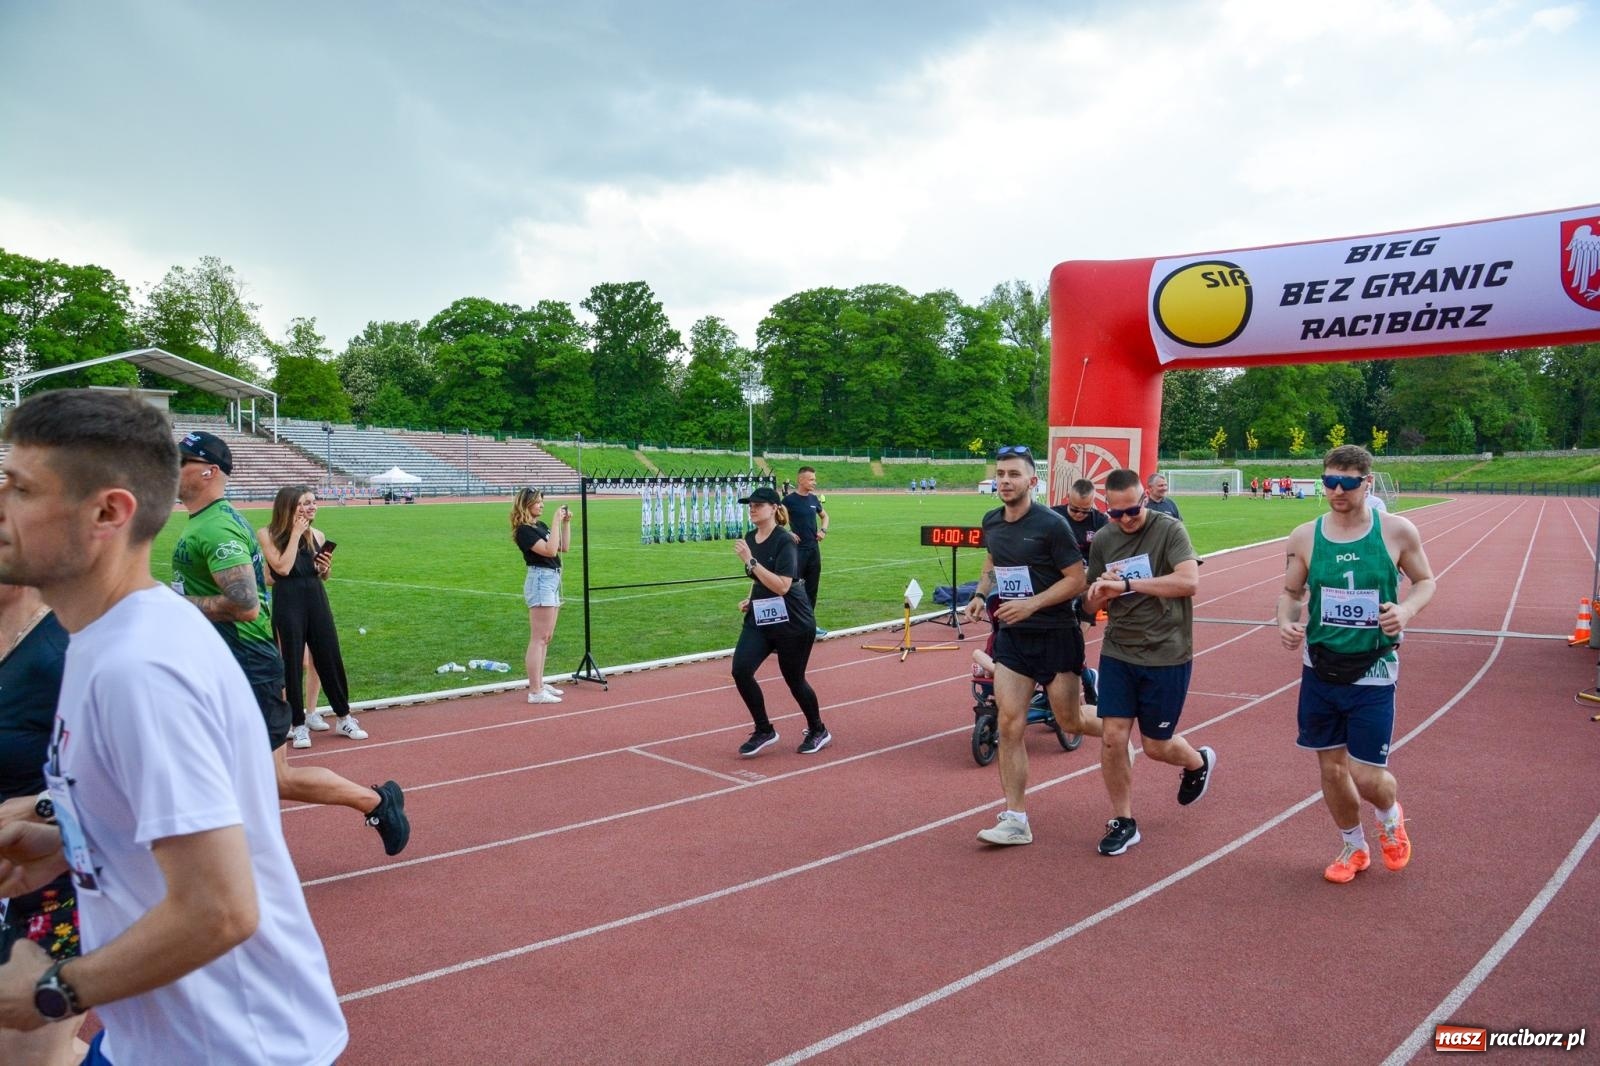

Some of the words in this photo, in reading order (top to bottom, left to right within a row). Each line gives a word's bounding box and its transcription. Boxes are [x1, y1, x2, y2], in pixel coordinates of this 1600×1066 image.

[1344, 237, 1440, 264] BIEG
[1201, 269, 1250, 288] SIR
[1279, 277, 1355, 307] BEZ
[1361, 260, 1514, 299] GRANIC
[1300, 302, 1494, 341] RACIBÓRZ
[933, 528, 980, 544] 0:00:12
[1336, 552, 1360, 563] POL
[1003, 580, 1022, 591] 207
[1342, 570, 1355, 590] 1
[761, 607, 778, 618] 178
[1335, 604, 1364, 618] 189
